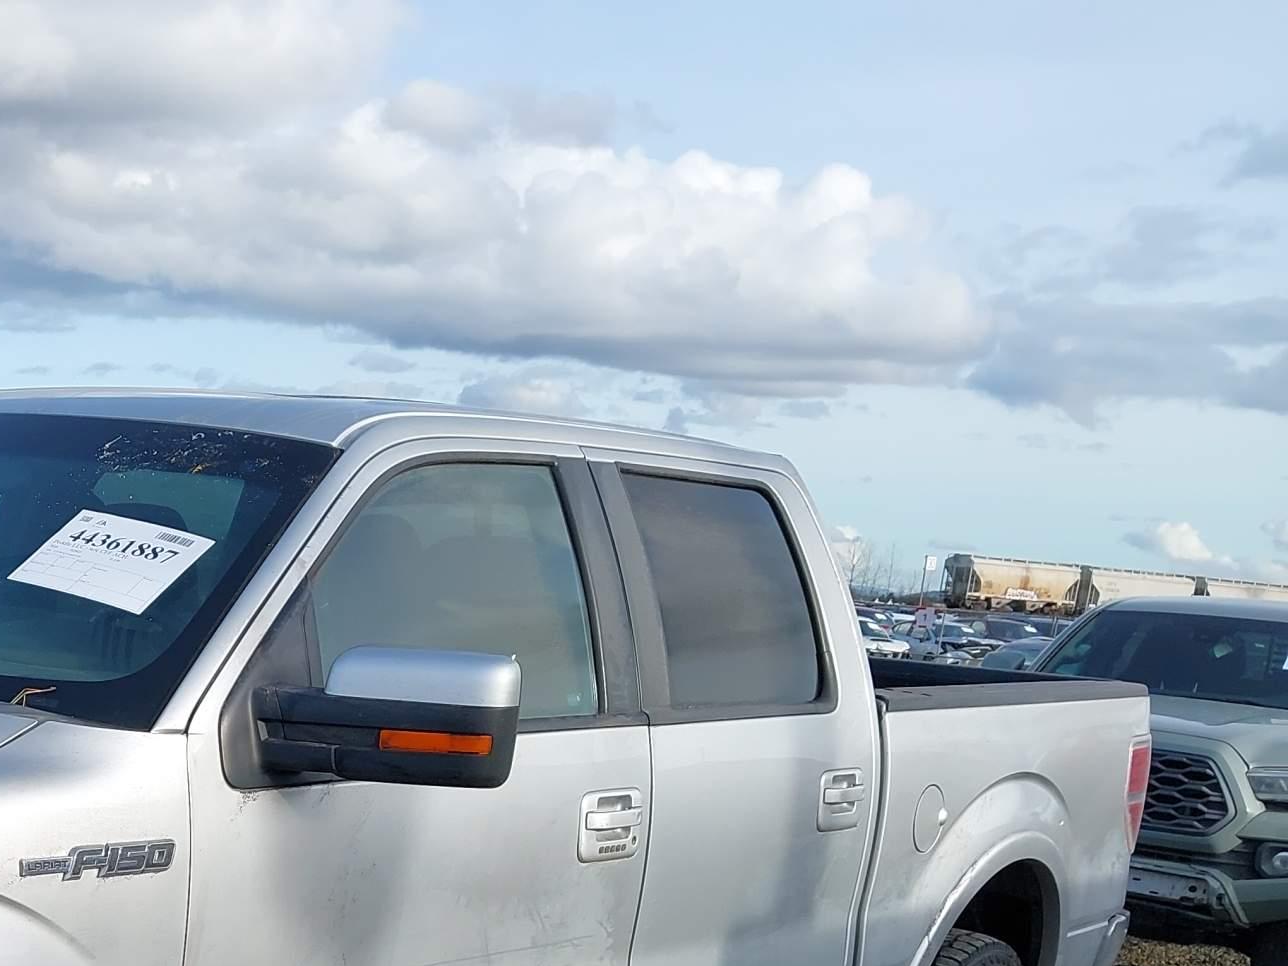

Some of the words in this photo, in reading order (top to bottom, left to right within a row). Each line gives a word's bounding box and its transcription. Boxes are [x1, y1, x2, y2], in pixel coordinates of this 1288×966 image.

[68, 530, 179, 564] 44361887
[27, 858, 69, 871] LARIAT
[62, 839, 176, 881] F-150
